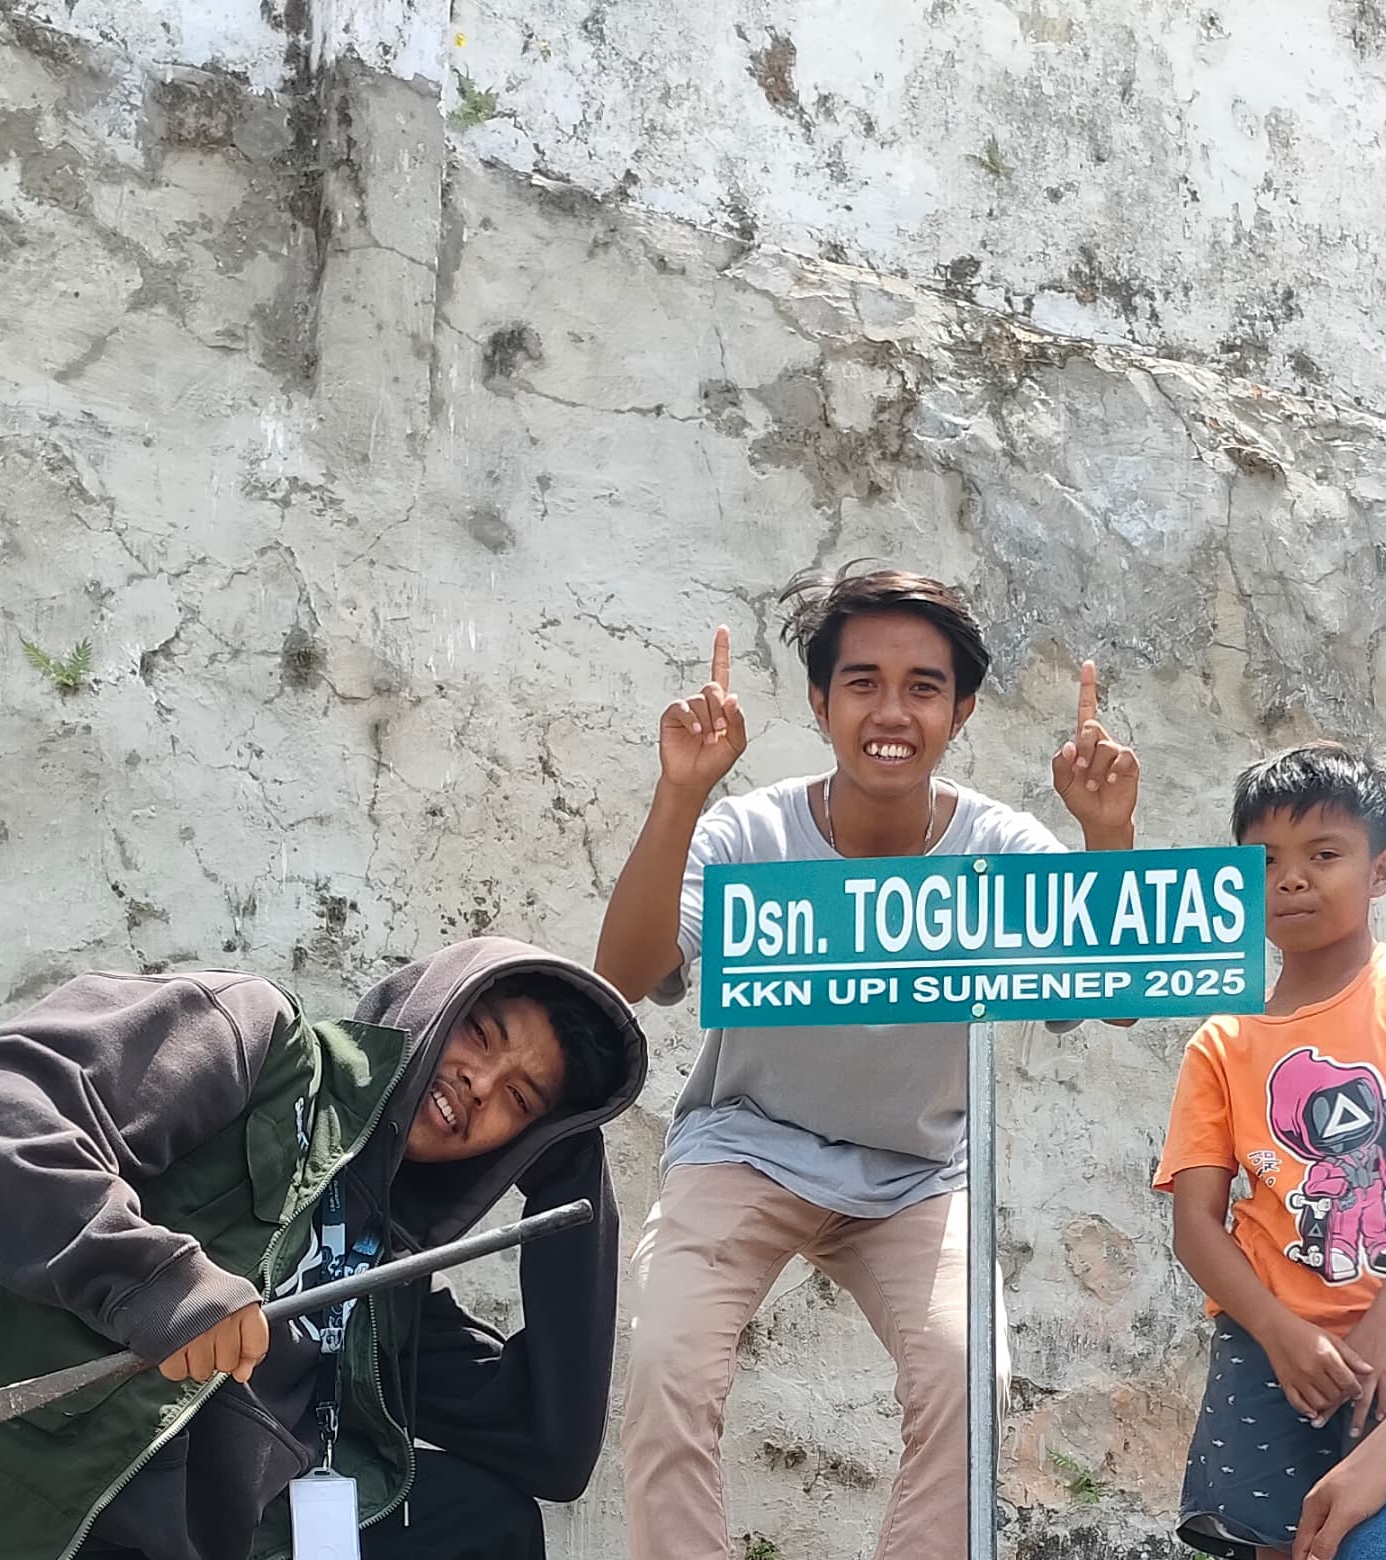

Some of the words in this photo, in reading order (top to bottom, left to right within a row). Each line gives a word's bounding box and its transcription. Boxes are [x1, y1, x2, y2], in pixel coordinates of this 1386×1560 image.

[722, 883, 829, 957] Dsn.
[844, 871, 1100, 953] TOGULUK
[1109, 866, 1245, 945] ATAS
[722, 980, 812, 1008] KKN
[827, 978, 899, 1005] UPI
[912, 971, 1132, 1003] SUMENEP
[1144, 968, 1247, 997] 2025
